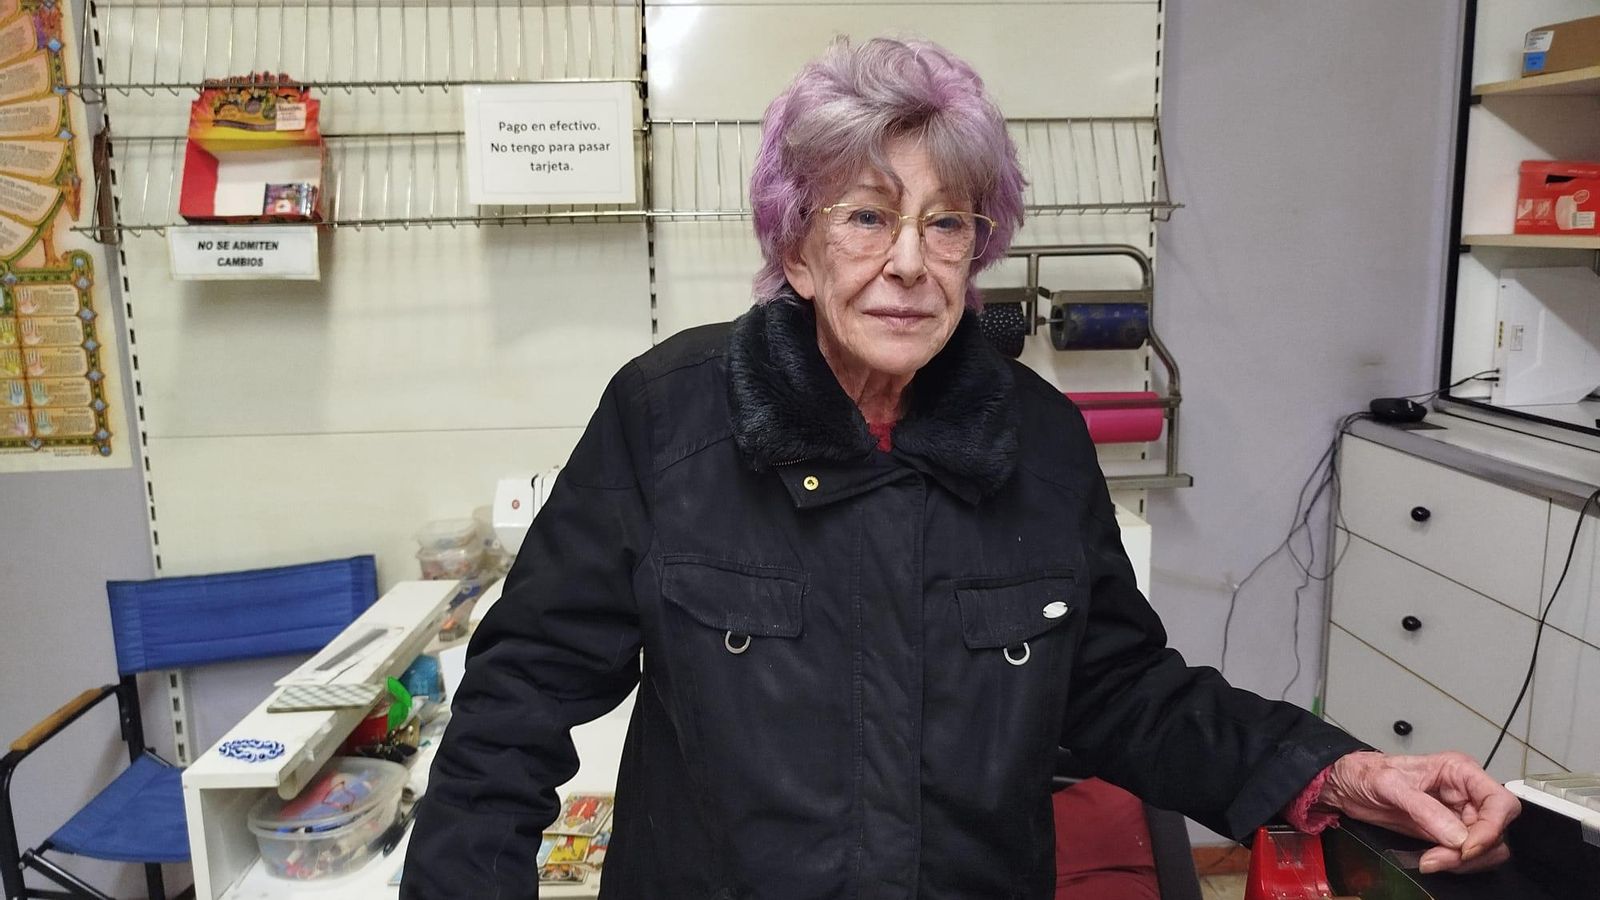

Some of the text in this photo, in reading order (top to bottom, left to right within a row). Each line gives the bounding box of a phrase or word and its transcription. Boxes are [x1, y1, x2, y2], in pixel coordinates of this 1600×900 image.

[499, 121, 600, 134] Pago en efectivo.
[491, 142, 611, 155] No tengo para pasar
[530, 161, 574, 173] tarjeta.
[198, 241, 279, 251] NO SE ADMITEN
[217, 257, 264, 267] CAMBIOS
